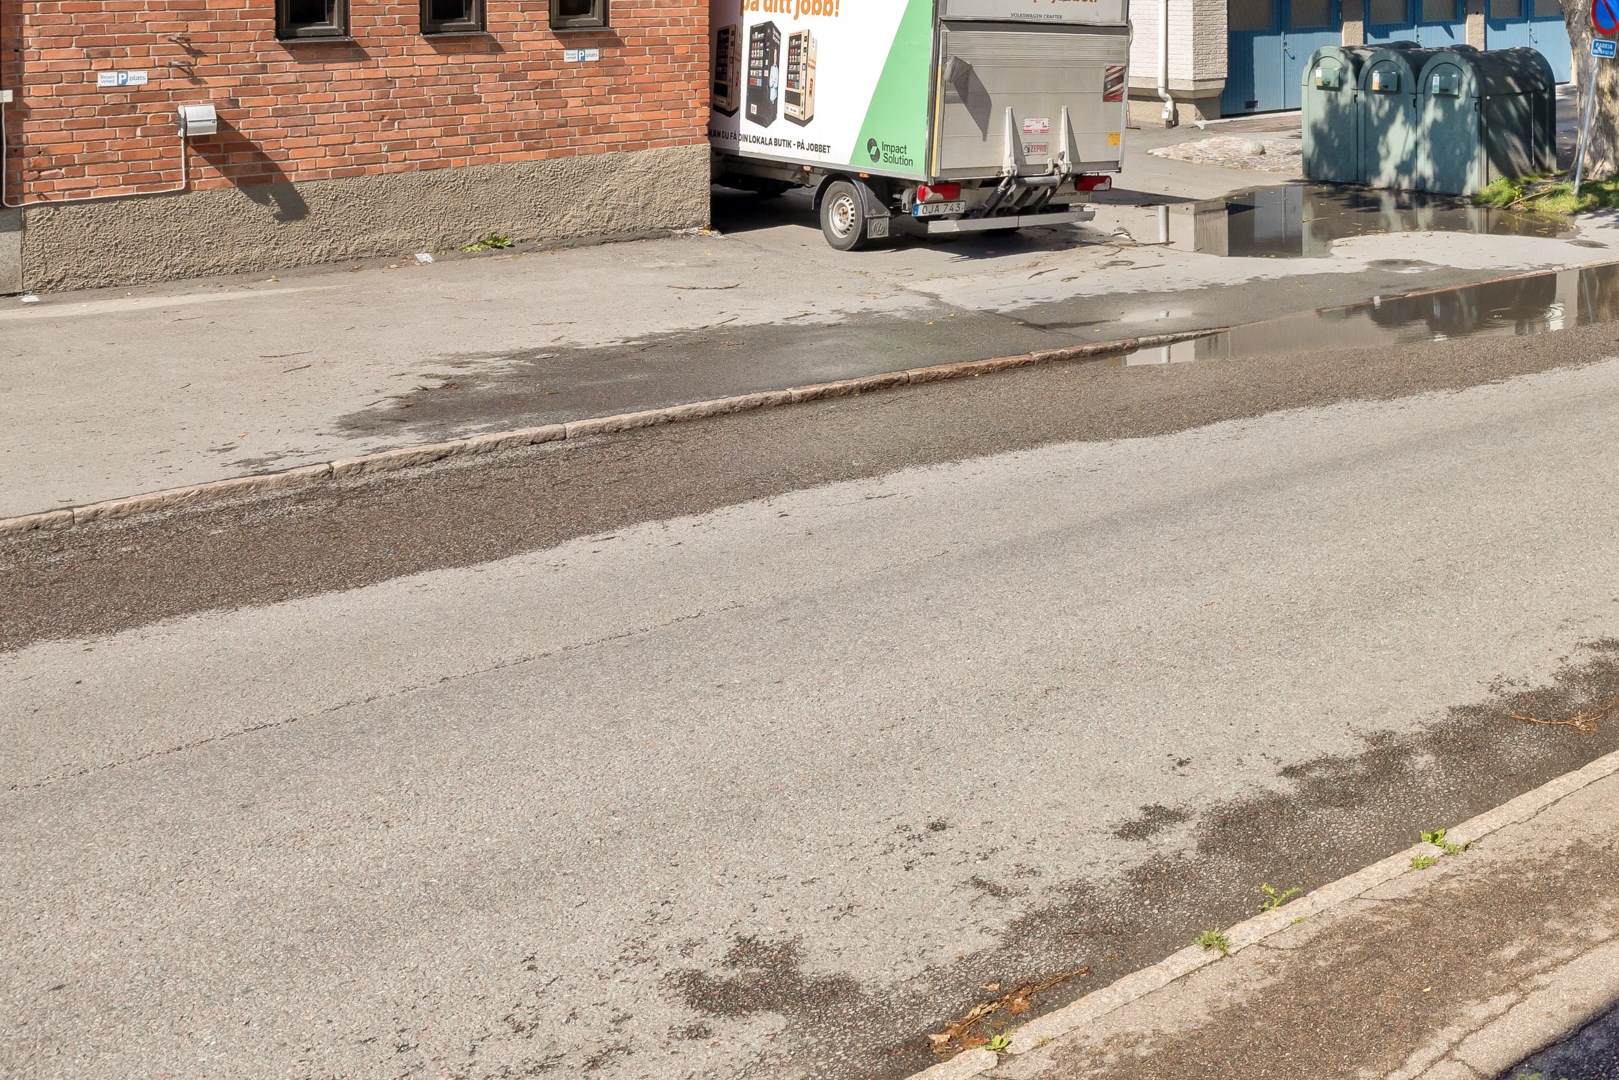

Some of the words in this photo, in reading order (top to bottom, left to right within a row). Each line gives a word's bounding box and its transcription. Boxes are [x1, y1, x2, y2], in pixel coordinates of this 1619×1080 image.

[749, 134, 773, 146] LOKALA
[774, 138, 792, 149] BUTIK
[796, 140, 806, 151] PÅ
[806, 142, 831, 154] JOBBET
[881, 141, 908, 155] Impact
[883, 152, 914, 167] Solution
[921, 204, 940, 215] OJA
[942, 203, 961, 213] 743
